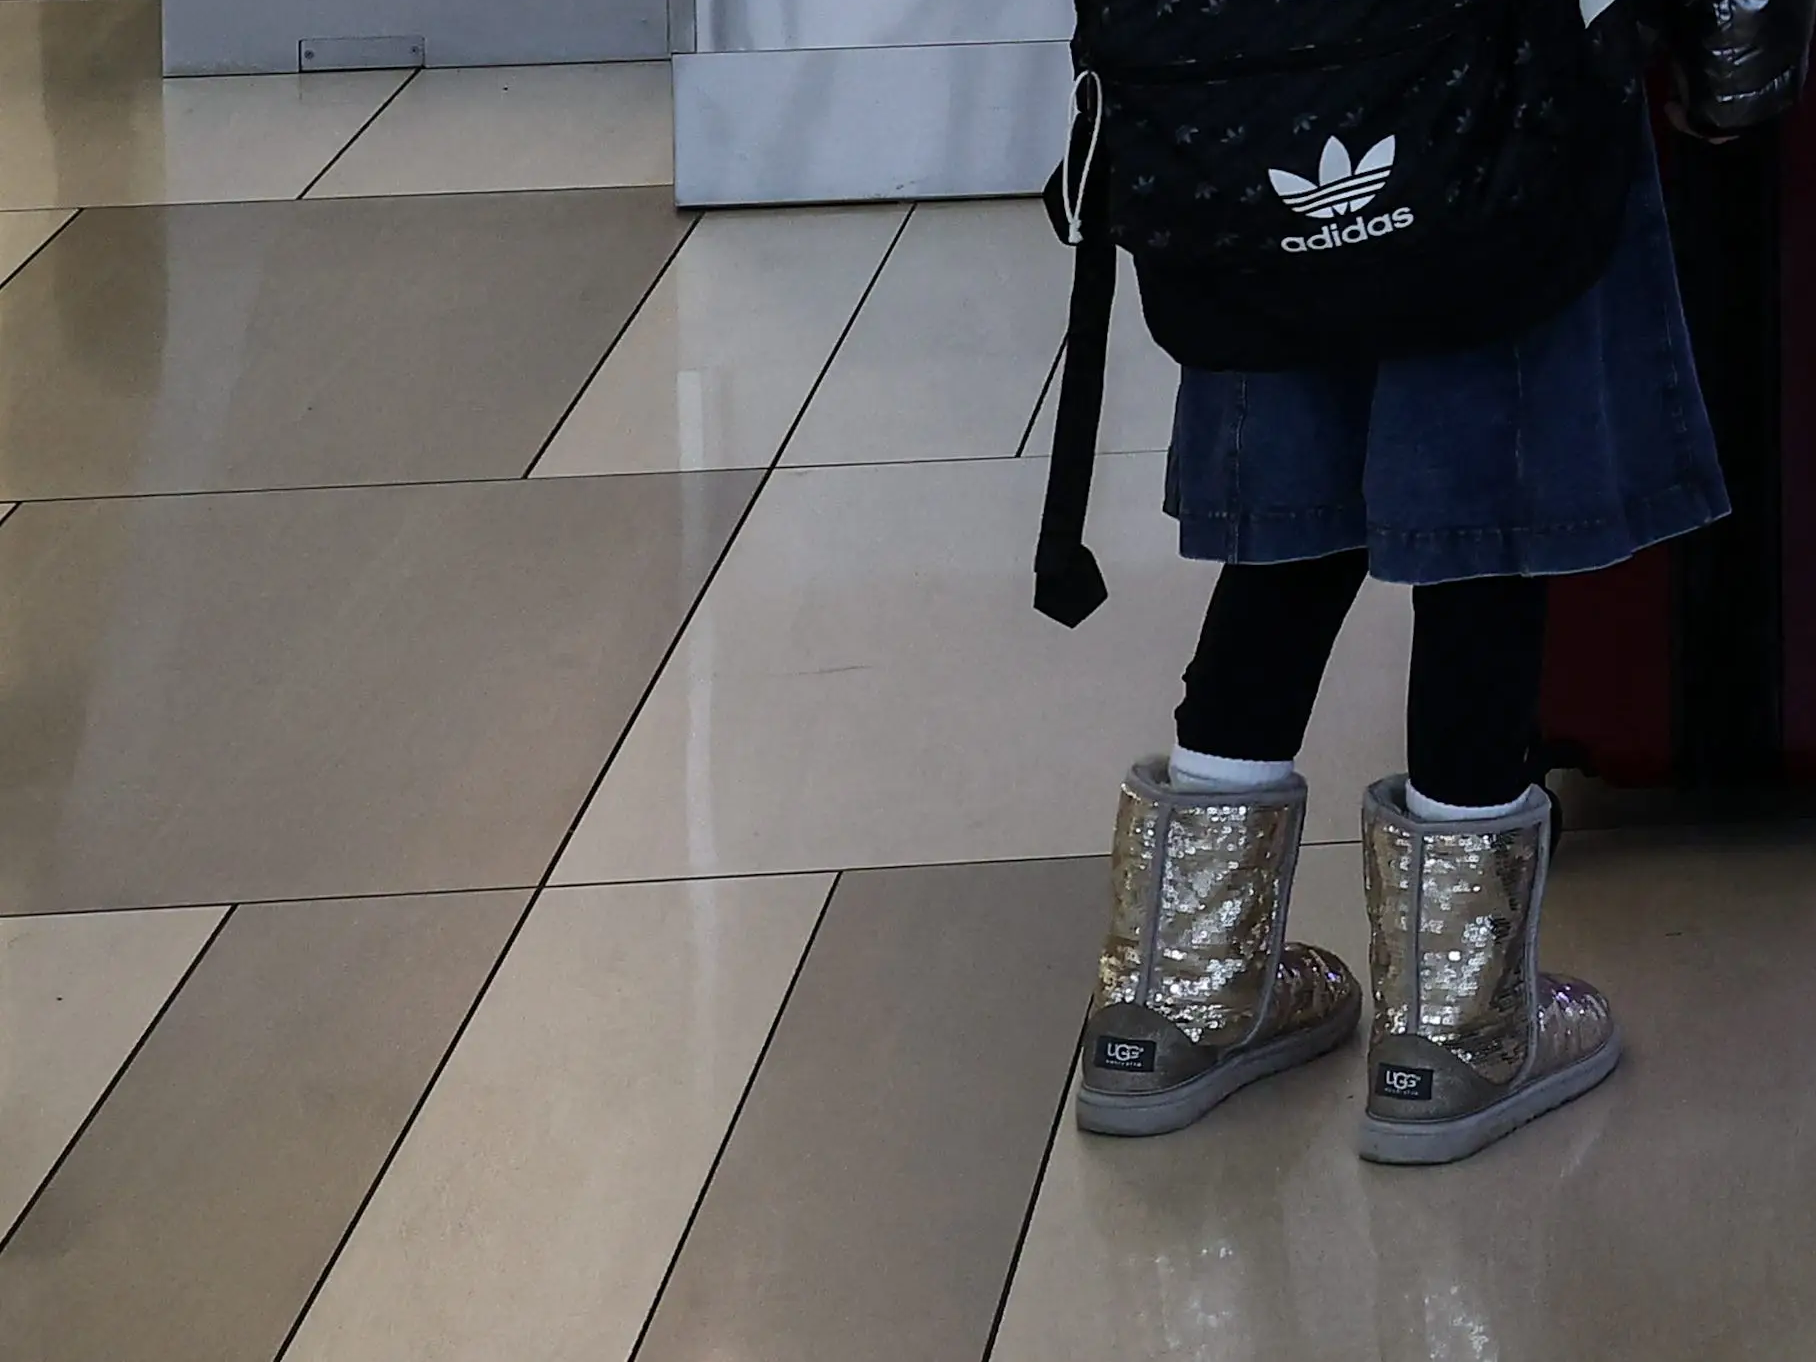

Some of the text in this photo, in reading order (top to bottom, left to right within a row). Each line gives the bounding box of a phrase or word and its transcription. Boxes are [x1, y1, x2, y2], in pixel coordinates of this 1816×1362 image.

[1281, 200, 1414, 252] adidas
[1107, 1043, 1141, 1060] UGG
[1386, 1071, 1418, 1088] UGG
